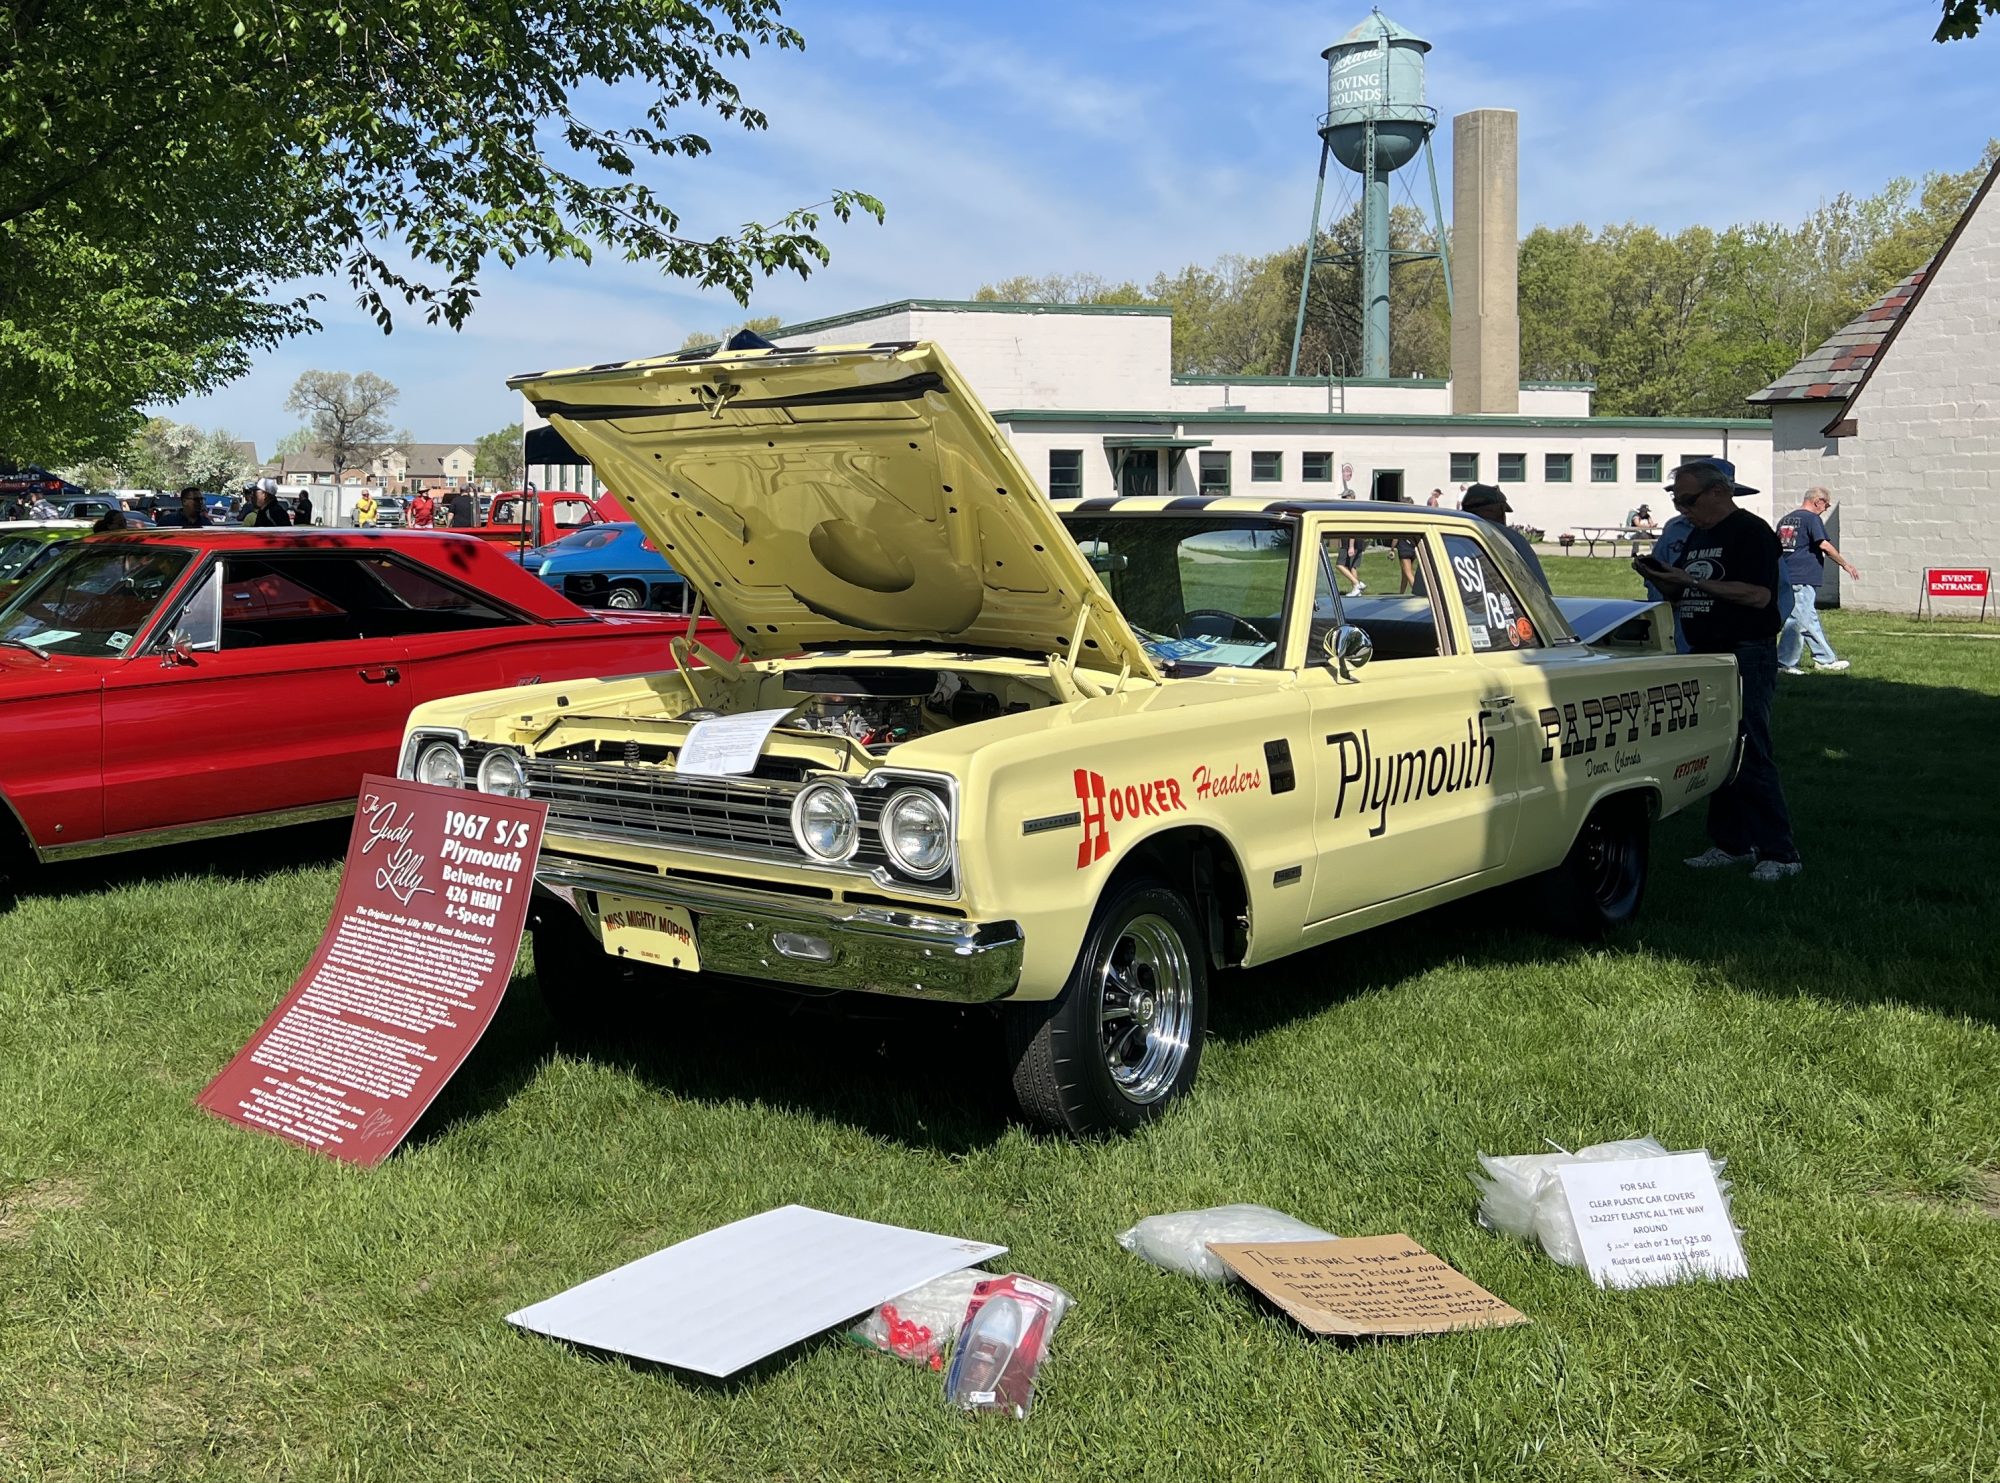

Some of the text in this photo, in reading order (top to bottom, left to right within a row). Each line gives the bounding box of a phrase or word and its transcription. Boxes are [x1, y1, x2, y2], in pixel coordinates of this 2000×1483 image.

[1931, 583, 1983, 591] ENTRANCE
[1539, 691, 1641, 763] PAPPY
[1647, 679, 1700, 737] FRY
[1192, 763, 1261, 800] Headers
[1326, 710, 1495, 838] Plymouth
[362, 794, 380, 814] The
[362, 801, 415, 861] Judy
[444, 810, 530, 849] 1967 S/S
[440, 839, 522, 873] Plymouth
[375, 848, 435, 906] Lilly
[442, 865, 503, 891] Belvedere
[446, 885, 503, 911] 426 HEMI
[356, 906, 368, 915] The
[367, 909, 393, 922] Original
[391, 914, 408, 926] Judy
[407, 918, 422, 929] Lilly
[422, 922, 436, 932] 1967
[436, 924, 454, 936] Hemi
[454, 928, 487, 944] Belvedere
[445, 903, 496, 928] 4-Speed
[604, 910, 690, 946] MISS MIGHTY MOPAR
[1620, 1181, 1657, 1192] FOR SALE
[1589, 1192, 1696, 1209] CLEAR PLASTIC CAR COVERS
[1589, 1205, 1705, 1223] 12x22FT ELASTIC ALL THE WAY
[1632, 1223, 1669, 1234] AROUND
[1634, 1240, 1652, 1249] each
[1663, 1238, 1670, 1246] 2
[1670, 1237, 1683, 1246] for
[1611, 1255, 1640, 1266] Richard
[1642, 1254, 1655, 1263] cell
[1656, 1252, 1672, 1262] 440
